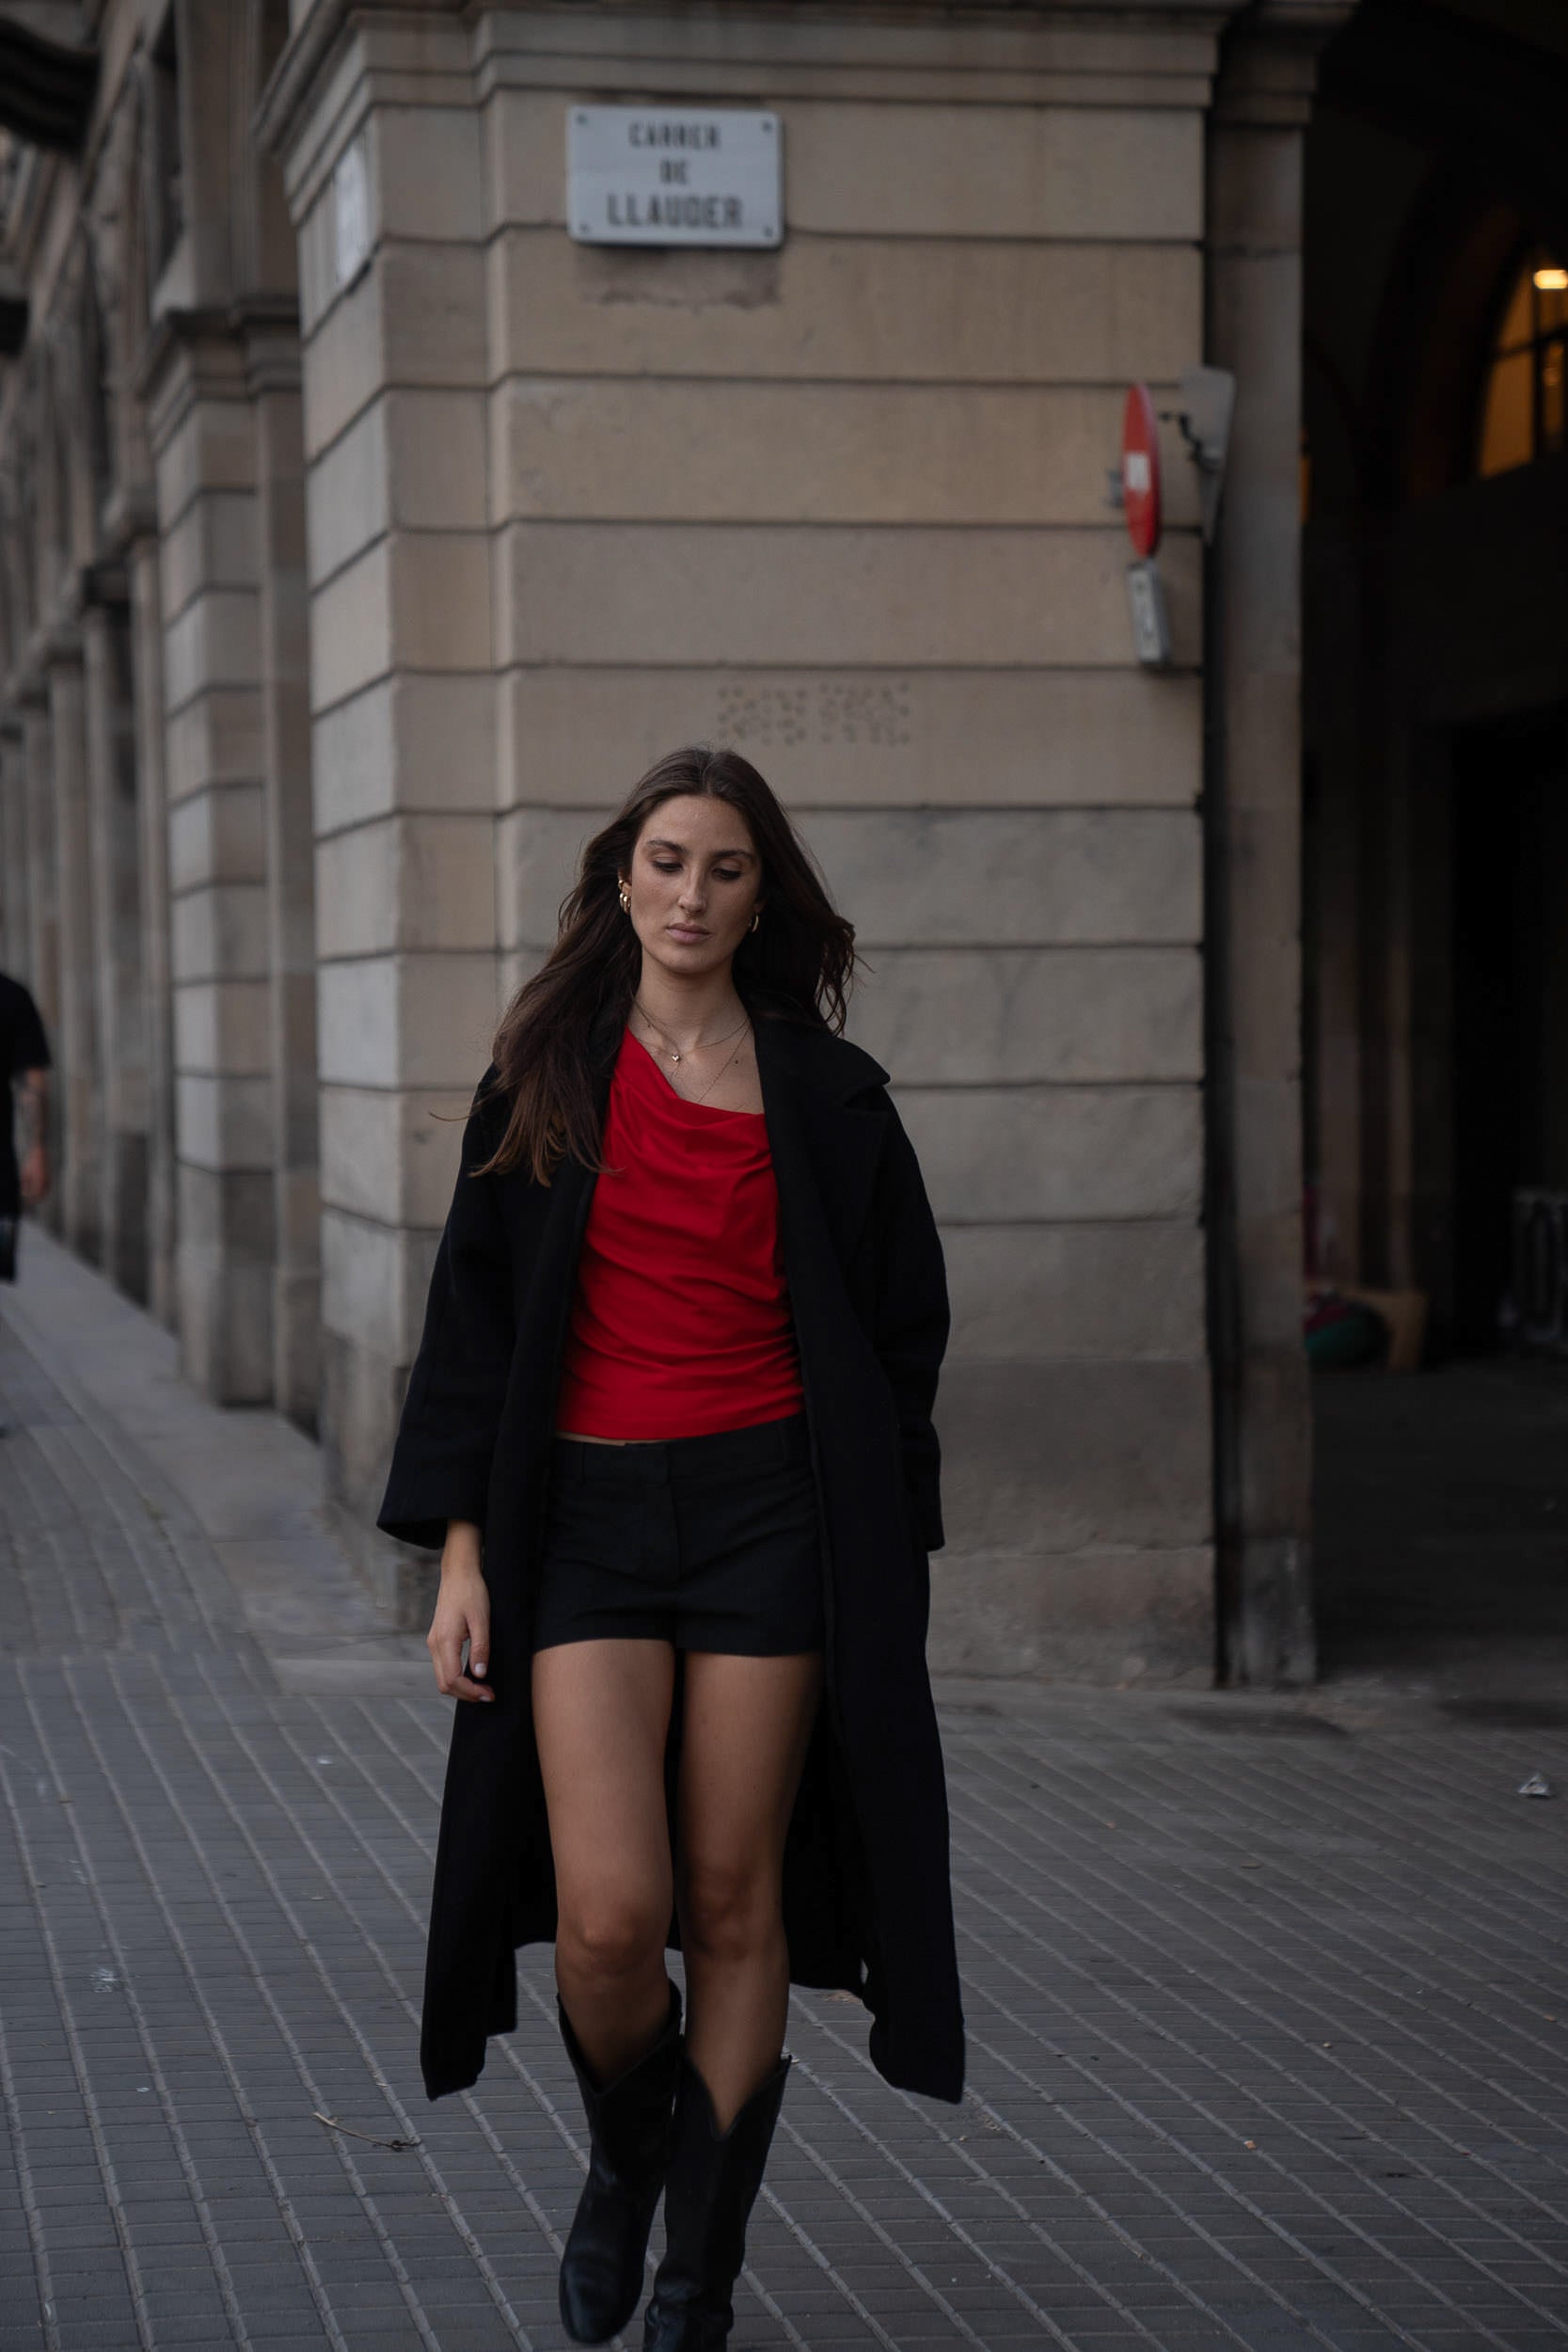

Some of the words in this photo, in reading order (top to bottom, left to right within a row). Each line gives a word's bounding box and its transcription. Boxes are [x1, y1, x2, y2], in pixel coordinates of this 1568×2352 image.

[628, 122, 721, 149] CARRER
[659, 157, 688, 184] DE
[607, 193, 743, 228] LLAUDER
